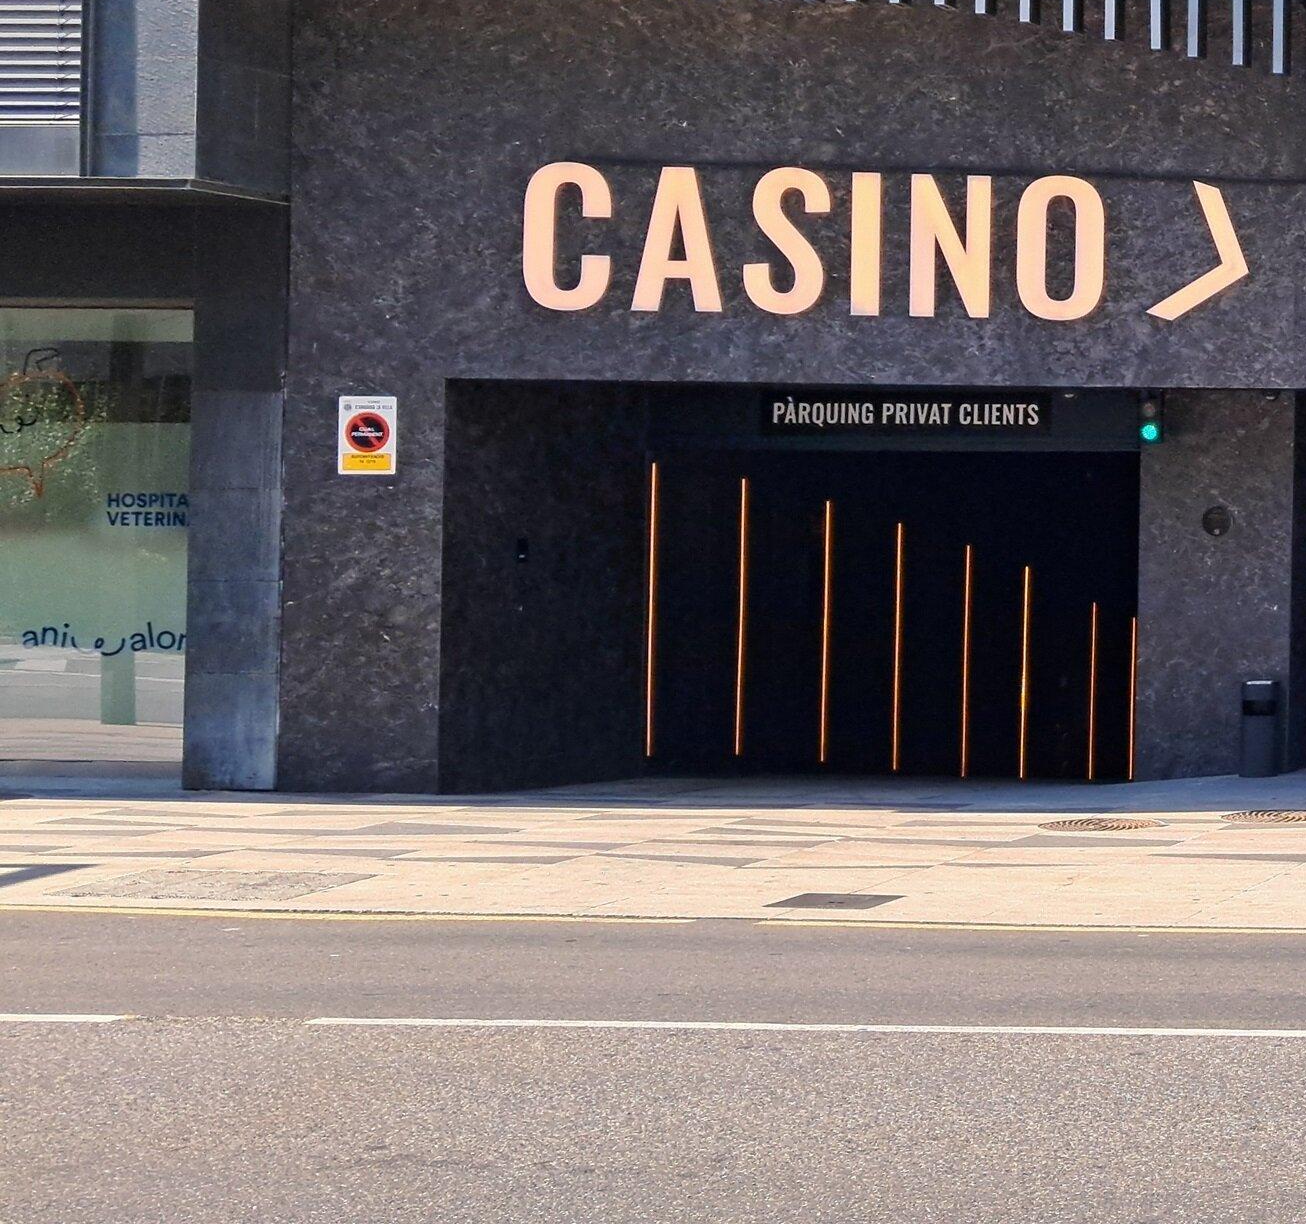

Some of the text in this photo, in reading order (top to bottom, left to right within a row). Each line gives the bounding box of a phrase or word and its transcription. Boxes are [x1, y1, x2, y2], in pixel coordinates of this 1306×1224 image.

[522, 162, 1105, 320] CASINO
[772, 397, 1040, 426] PÀRQUING PRIVAT CLIENTS
[107, 511, 190, 526] VETERIN
